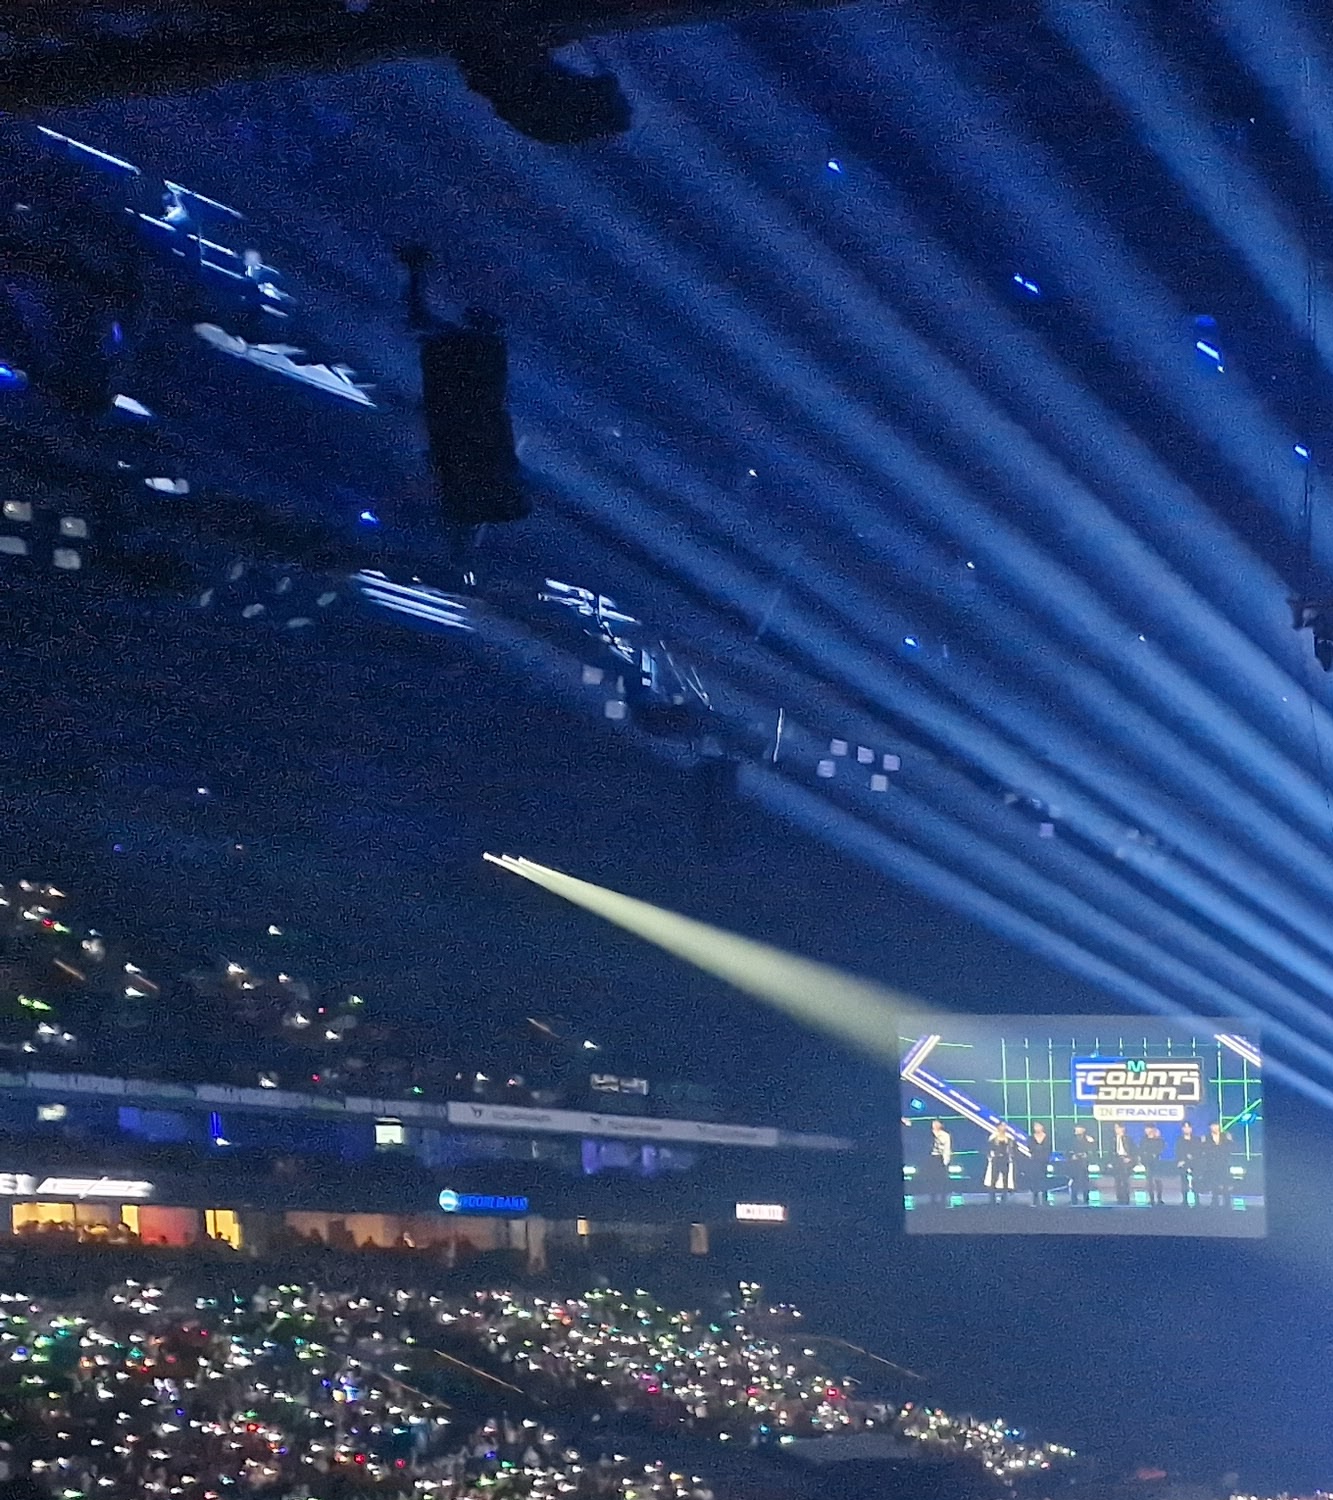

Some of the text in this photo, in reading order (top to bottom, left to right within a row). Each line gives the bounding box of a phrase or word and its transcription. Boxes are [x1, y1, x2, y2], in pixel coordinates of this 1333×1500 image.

[1127, 1060, 1145, 1072] M
[1086, 1071, 1188, 1085] COUNT
[1097, 1087, 1177, 1100] DOWN
[1115, 1108, 1178, 1117] FRANCE
